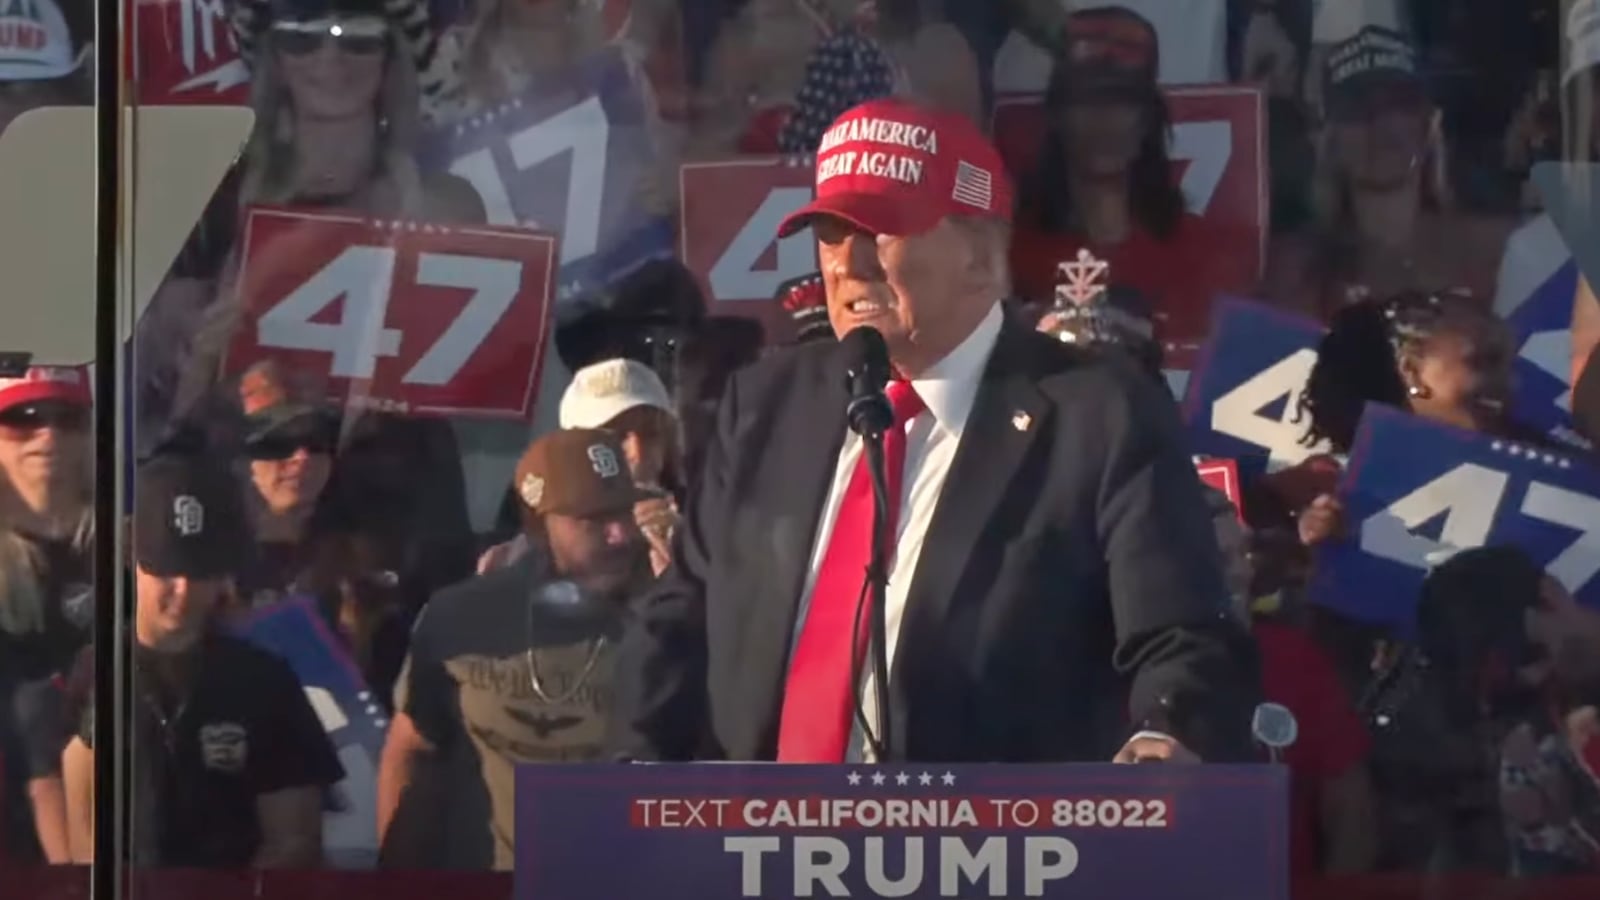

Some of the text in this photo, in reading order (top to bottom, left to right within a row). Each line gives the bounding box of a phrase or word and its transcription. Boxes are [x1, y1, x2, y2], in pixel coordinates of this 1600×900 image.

[850, 117, 937, 155] AMERICA
[856, 151, 922, 185] AGAIN
[709, 187, 816, 300] 4
[256, 245, 524, 387] 47
[1211, 347, 1345, 474] 4
[1360, 462, 1600, 594] 47
[636, 798, 1168, 829] TEXT CALIFORNIA TO 88022
[723, 835, 1080, 898] TRUMP
